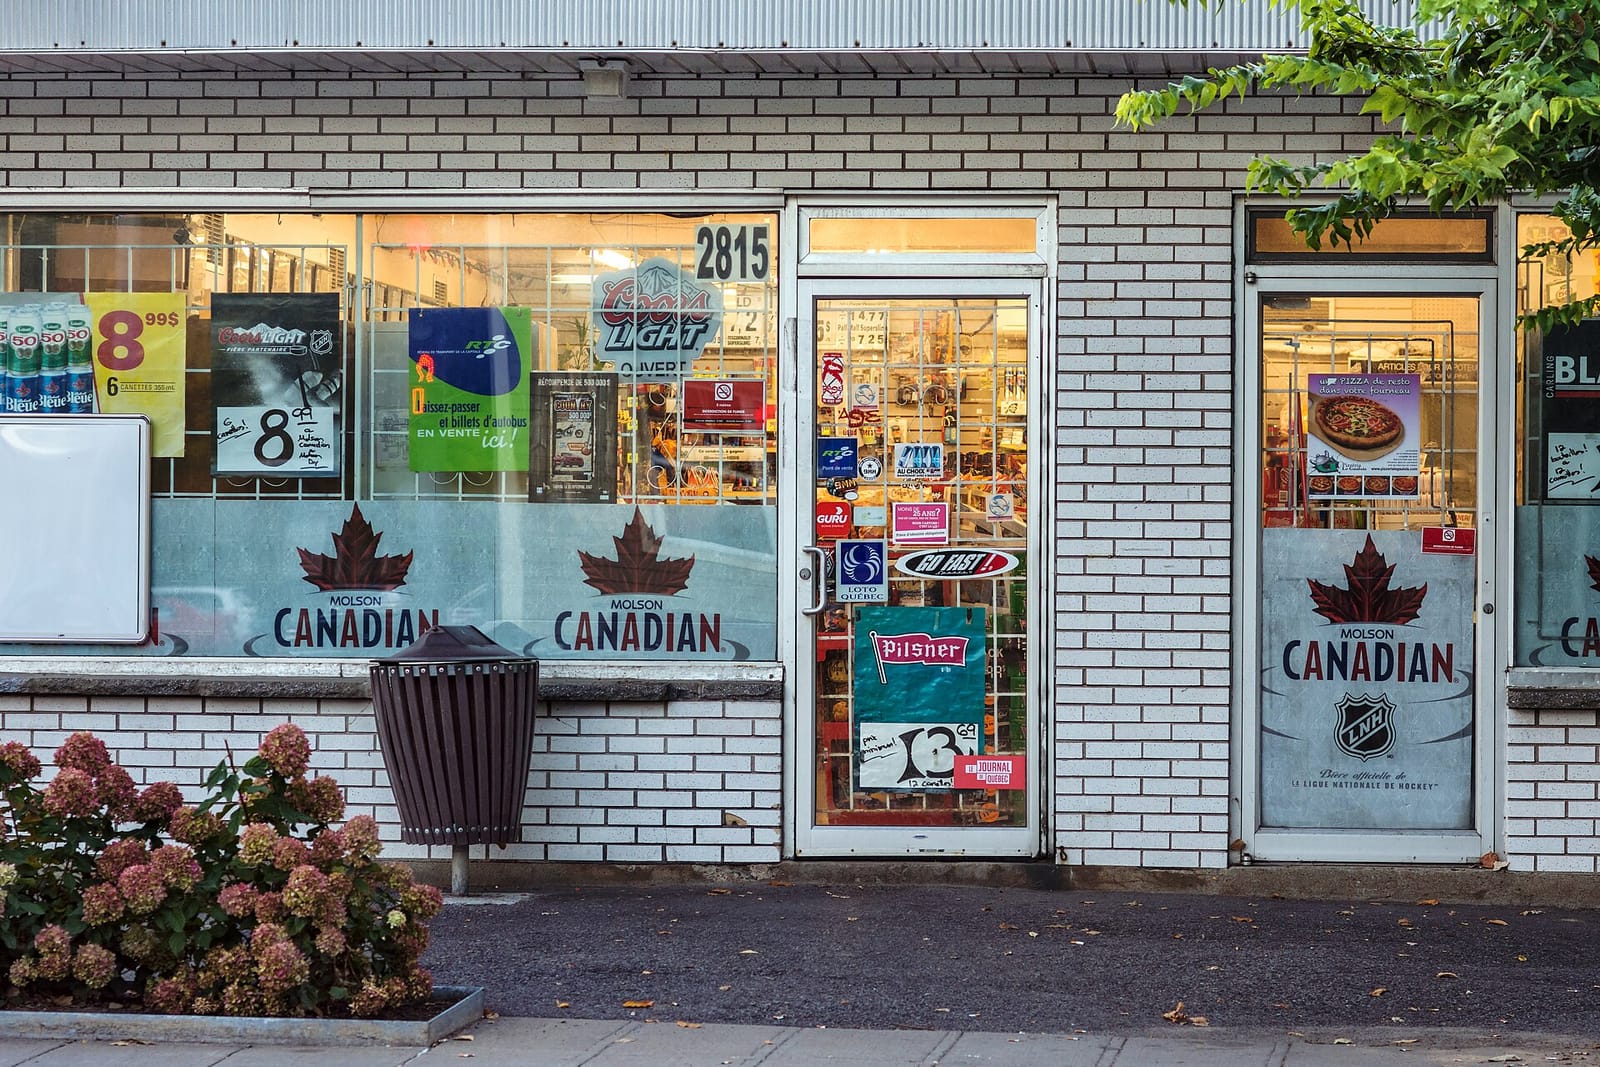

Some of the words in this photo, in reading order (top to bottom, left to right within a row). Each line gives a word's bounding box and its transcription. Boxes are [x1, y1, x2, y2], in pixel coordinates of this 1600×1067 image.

[697, 226, 769, 279] 2815
[601, 278, 711, 326] Coors
[13, 335, 37, 346] 50
[41, 332, 65, 343] 50
[68, 329, 89, 340] 50
[97, 310, 145, 371] 8
[145, 312, 179, 327] 99$
[218, 326, 263, 344] Coors
[262, 331, 307, 344] LIGHT
[605, 322, 709, 351] LIGHT
[465, 340, 512, 350] RTC
[1377, 363, 1416, 371] ARTICLES
[1555, 356, 1600, 384] BL
[1340, 377, 1370, 385] PIZZA
[1372, 377, 1385, 385] de
[1388, 377, 1411, 385] resto
[1545, 355, 1555, 398] CARLING
[107, 376, 119, 396] 6
[1320, 386, 1341, 394] dans
[1344, 386, 1366, 394] votre
[1370, 386, 1411, 395] fourneau
[6, 396, 39, 413] Bleue
[292, 407, 312, 421] 99
[439, 416, 448, 428] et
[451, 415, 481, 428] billets
[484, 415, 527, 428] d'autobus
[254, 409, 294, 467] 8
[417, 429, 435, 438] EN
[440, 429, 481, 438] VENTE
[817, 514, 849, 524] GURU
[915, 554, 945, 572] GO
[941, 553, 987, 571] FAST
[330, 596, 382, 606] MOLSON
[610, 599, 663, 610] MOLSON
[554, 611, 721, 652] CANADIAN
[1340, 629, 1394, 640] MOLSON
[882, 639, 961, 658] Pilsner
[1283, 640, 1454, 683] CANADIAN
[957, 724, 976, 738] 69
[1348, 708, 1384, 745] LNH
[897, 727, 964, 784] 13
[978, 761, 1011, 773] JOURNAL
[987, 774, 1009, 783] QUÉBEC
[1319, 769, 1349, 779] Bière
[1352, 771, 1391, 780] officielle
[1395, 771, 1406, 780] de
[1333, 781, 1380, 789] NATIONALE
[1398, 782, 1433, 790] HOCKEY
